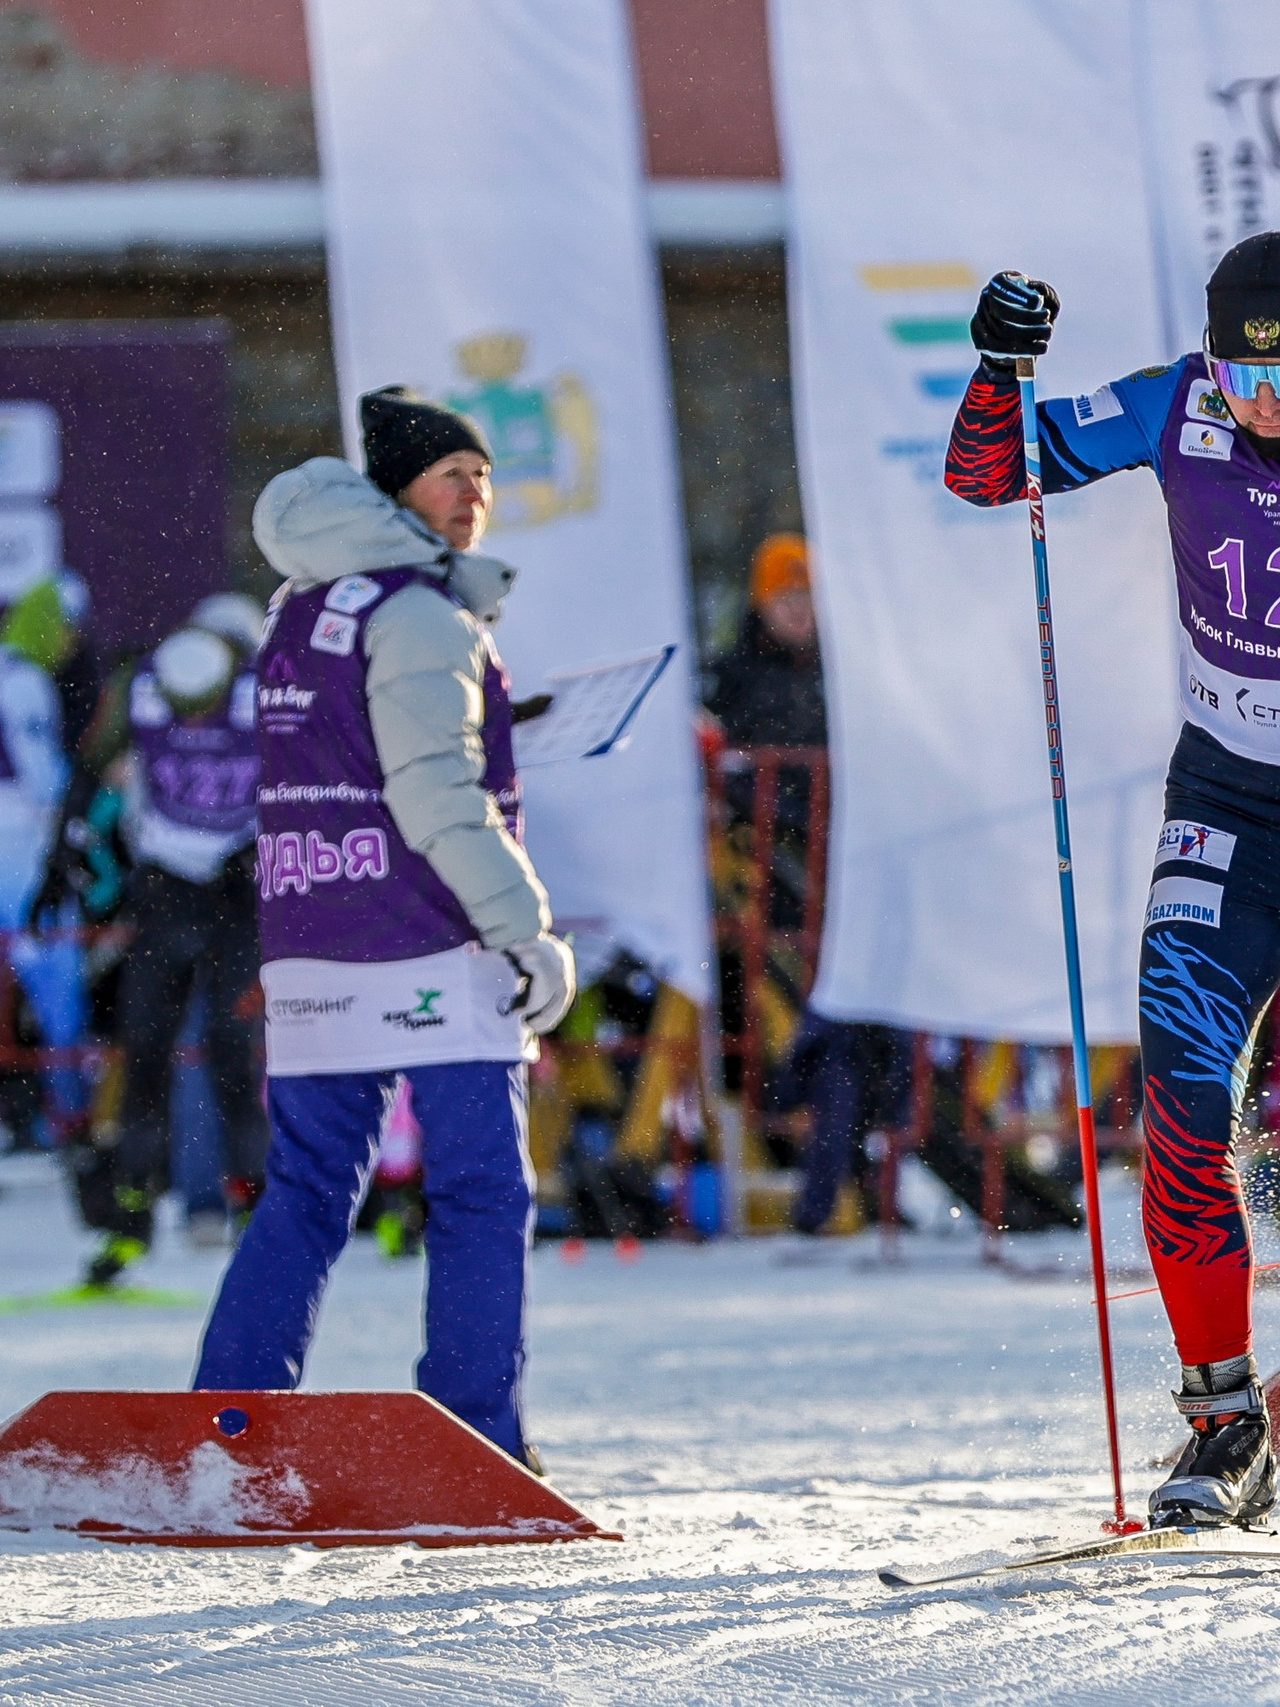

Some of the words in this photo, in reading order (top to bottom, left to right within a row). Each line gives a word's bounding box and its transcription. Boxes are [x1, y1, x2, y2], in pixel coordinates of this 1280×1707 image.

[1247, 487, 1277, 507] Тур
[1190, 604, 1223, 643] Кубок
[1226, 631, 1280, 659] Главы
[1152, 903, 1215, 923] GAZPROM
